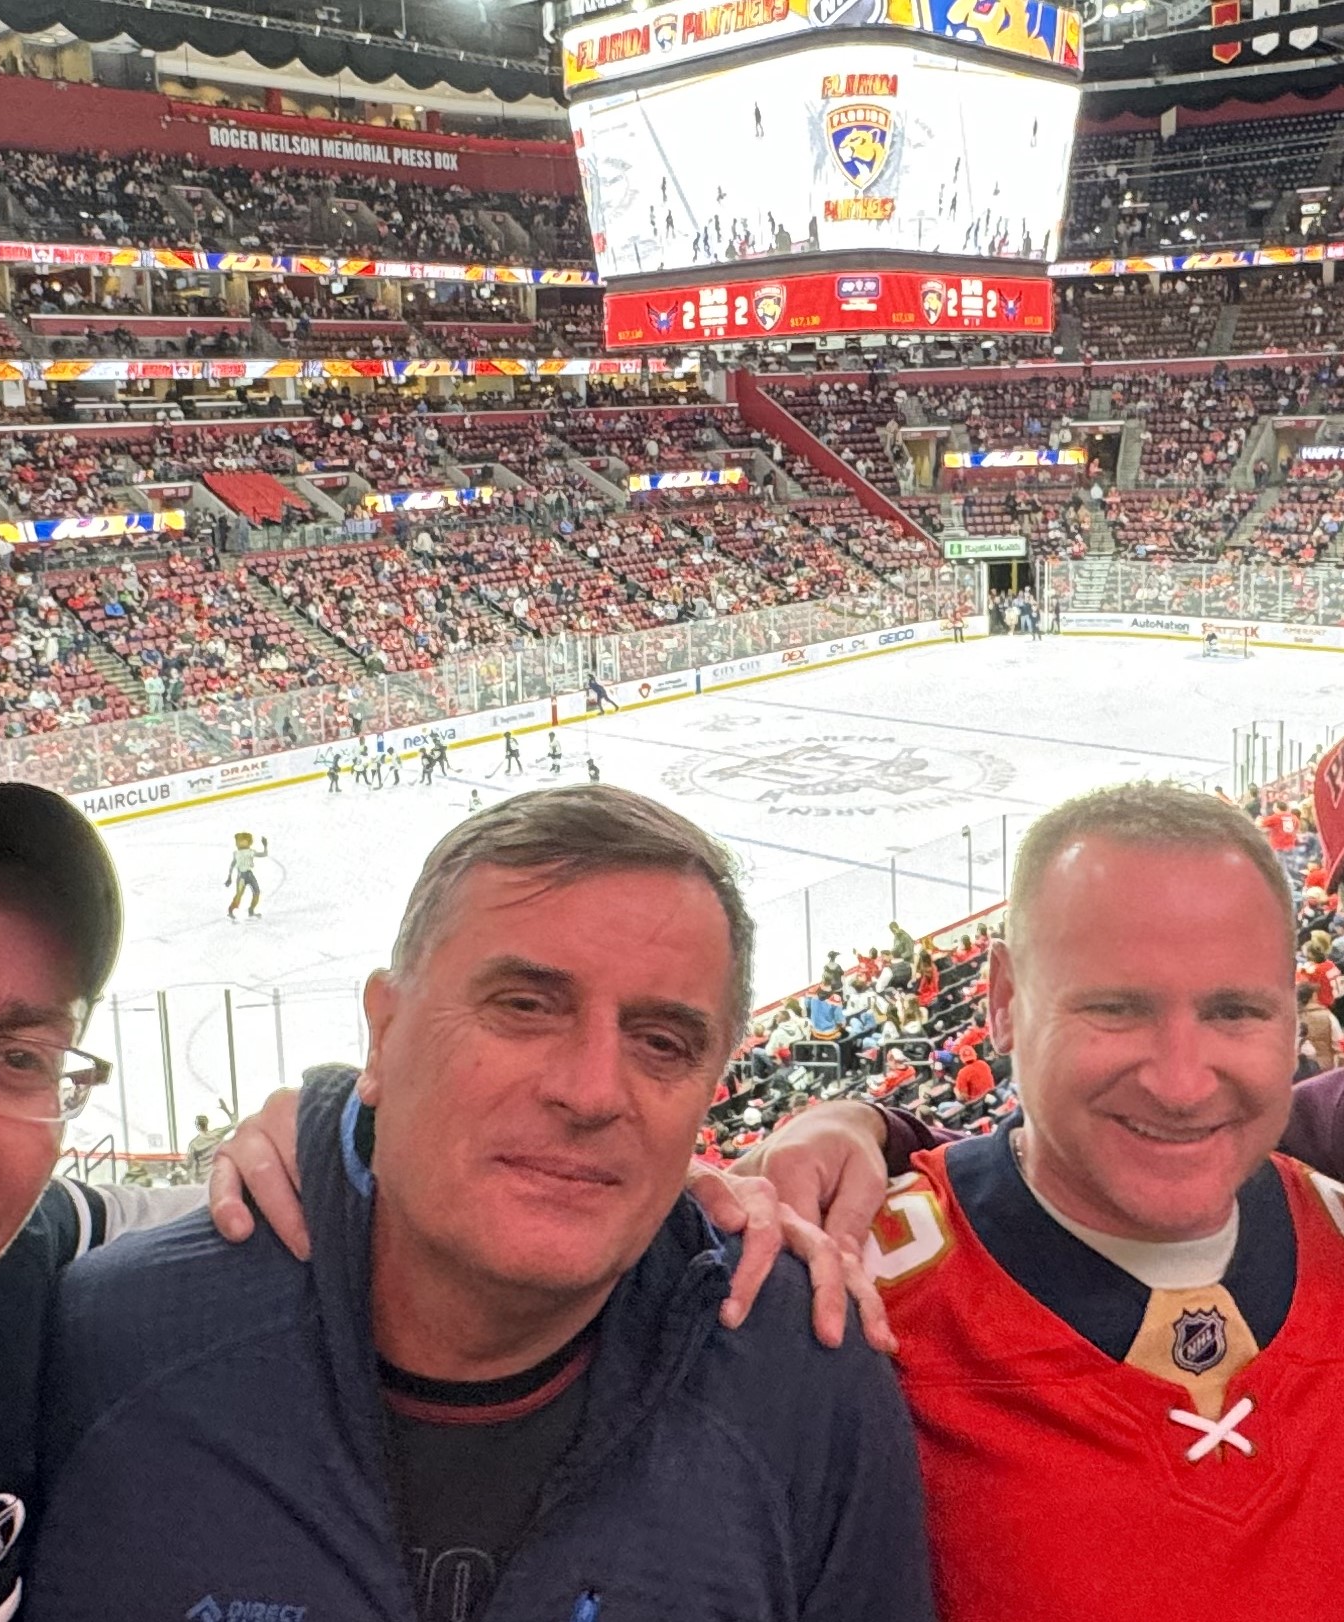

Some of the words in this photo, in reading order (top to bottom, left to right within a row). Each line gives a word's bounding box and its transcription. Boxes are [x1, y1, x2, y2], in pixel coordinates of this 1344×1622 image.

[577, 24, 650, 72] FLORIDA
[681, 0, 790, 45] PANTHERS
[821, 74, 898, 100] FLORIDA
[209, 126, 258, 150] ROGER
[260, 131, 321, 157] NEILSON
[321, 139, 392, 165] MEMORIAL
[393, 147, 432, 169] PRESS
[434, 151, 459, 171] BOX
[682, 300, 696, 330] 2
[735, 295, 748, 325] 2
[946, 287, 958, 317] 2
[986, 289, 997, 318] 2
[1302, 446, 1339, 459] HAPPY
[878, 628, 915, 646] GEICO
[1130, 617, 1190, 633] AutoNation
[782, 648, 806, 664] DEX
[220, 760, 270, 778] DRAKE
[83, 783, 171, 815] HAIRCLUB
